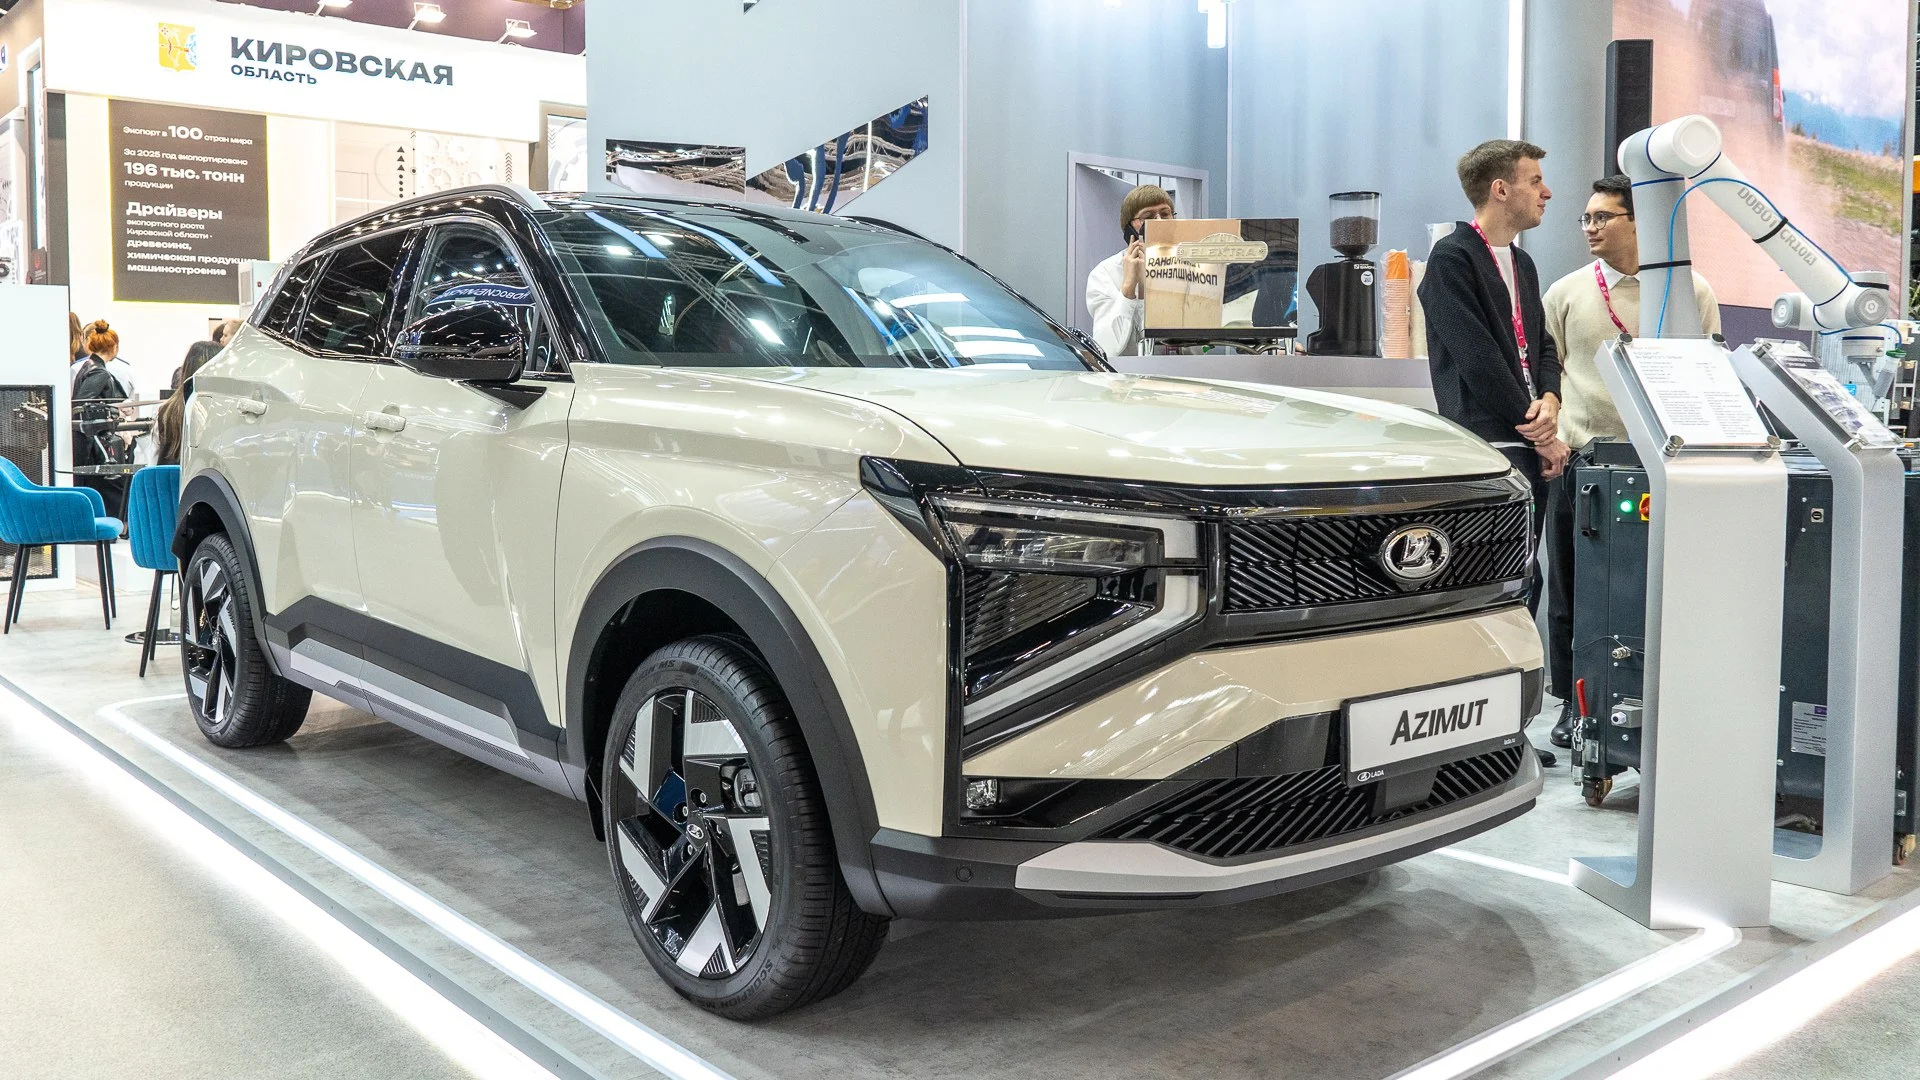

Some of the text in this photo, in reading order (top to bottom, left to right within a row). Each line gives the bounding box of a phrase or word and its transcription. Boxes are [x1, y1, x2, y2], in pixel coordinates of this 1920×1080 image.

[230, 36, 454, 86] КИРОВСКАЯ
[230, 64, 317, 85] ОБЛАСТЬ
[123, 126, 161, 137] Экспорт
[168, 125, 203, 140] 100
[204, 134, 229, 143] стран
[230, 137, 253, 145] мира
[123, 148, 248, 166] За 2025 год экспортировано
[123, 162, 245, 183] 196 тыс. тонн
[124, 180, 173, 189] продукции
[126, 201, 223, 220] Драйверы
[1737, 186, 1778, 229] DOBOT
[126, 220, 205, 230] экспортного роста
[126, 228, 173, 237] Кировской
[174, 230, 209, 239] области
[127, 240, 192, 251] древесина,
[127, 252, 197, 262] химическая
[127, 264, 227, 276] машиностроение
[1390, 698, 1489, 746] AZIMUT
[1371, 769, 1385, 778] LADA
